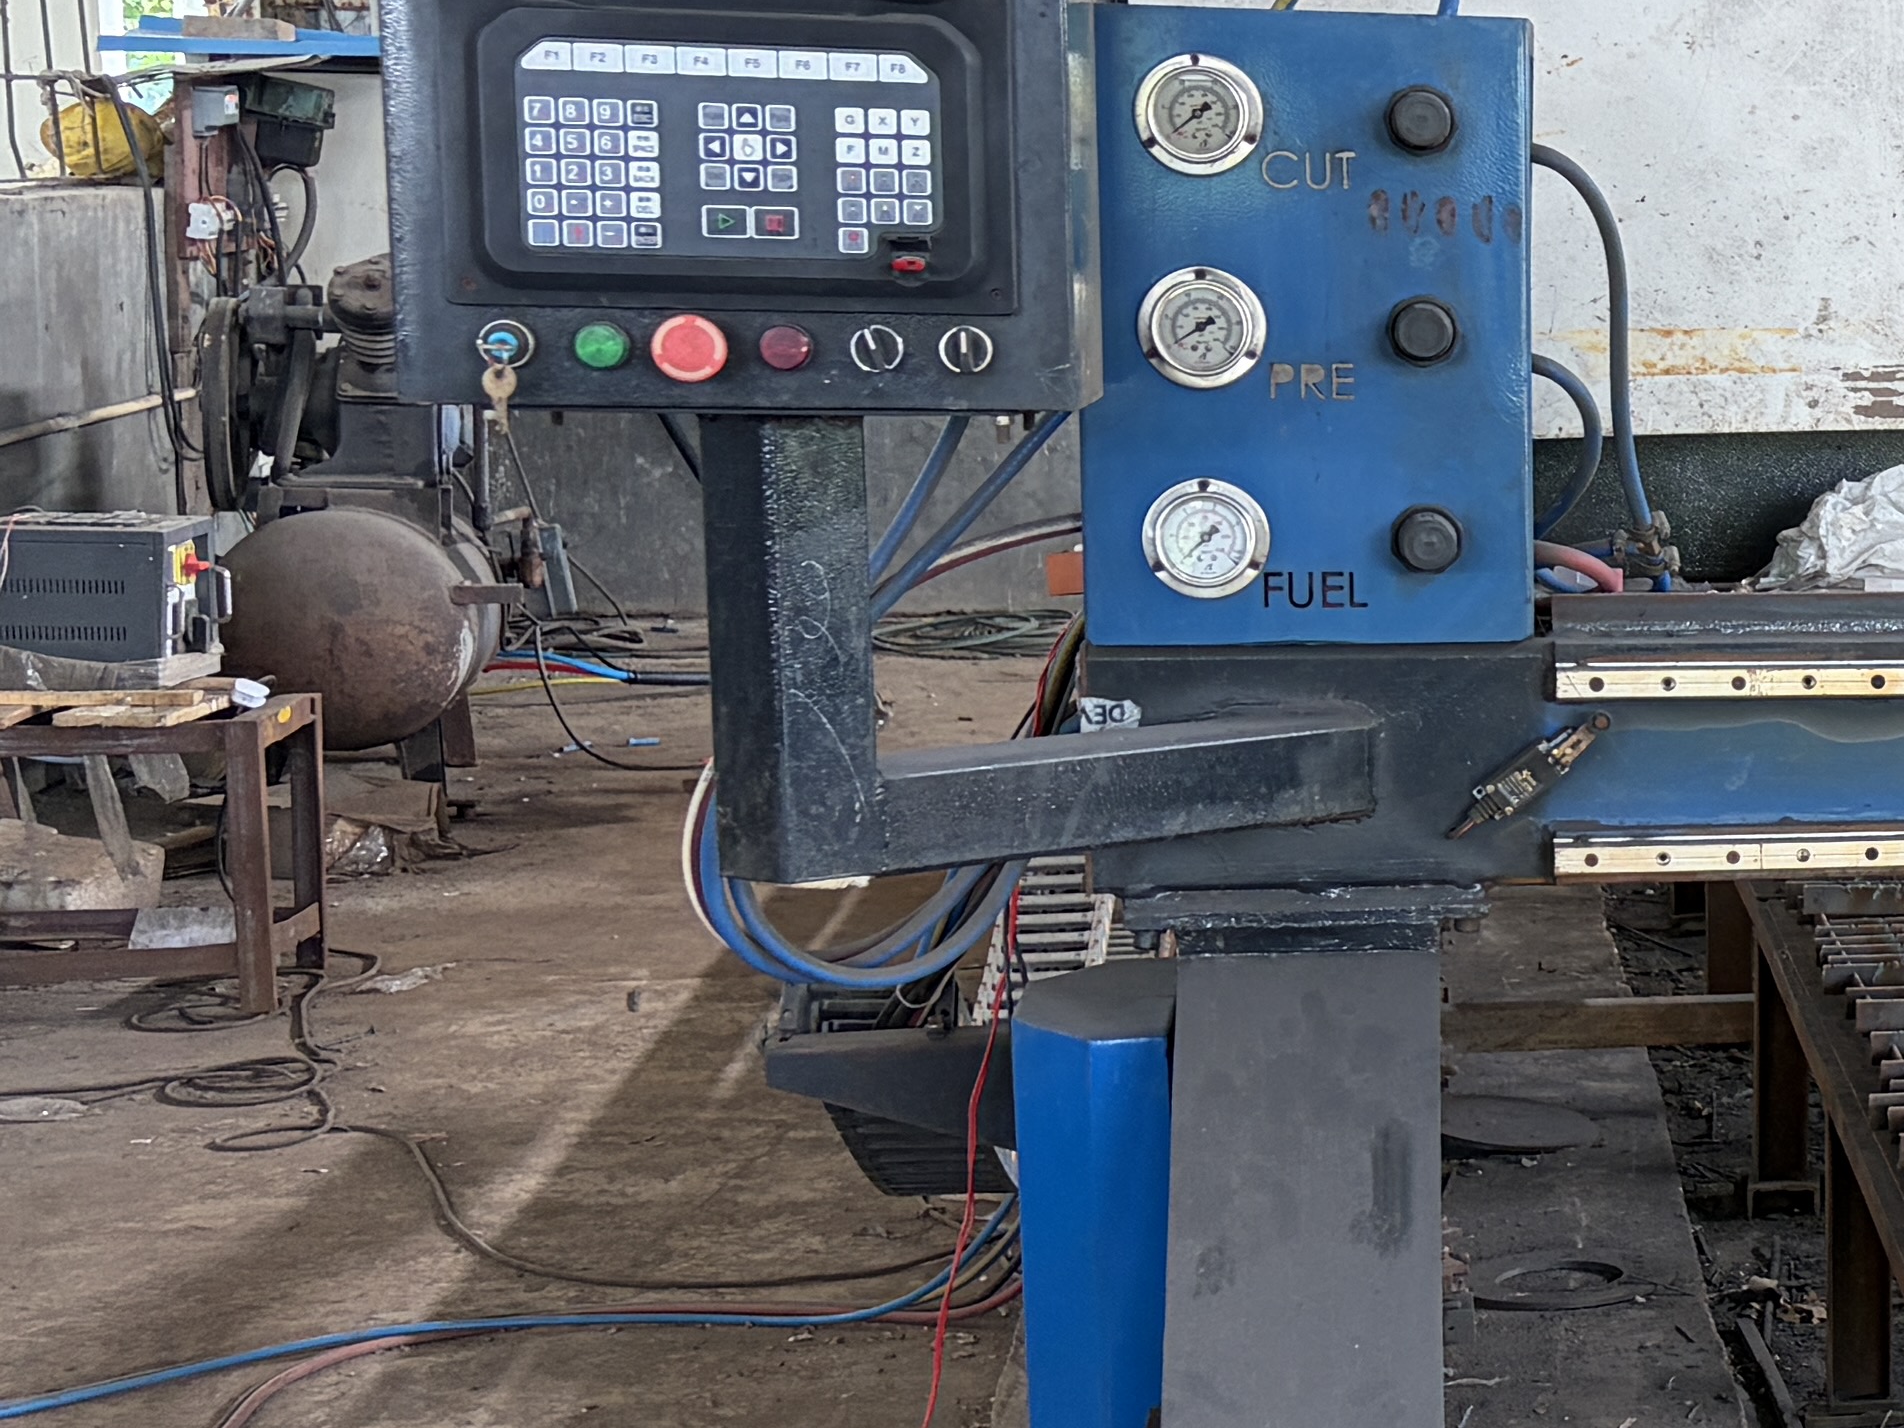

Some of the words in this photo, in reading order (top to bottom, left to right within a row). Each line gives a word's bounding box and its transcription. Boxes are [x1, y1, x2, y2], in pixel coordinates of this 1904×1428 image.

[544, 50, 560, 61] F1
[590, 52, 607, 63] F2
[641, 54, 658, 65] F3
[693, 56, 710, 66] F4
[744, 58, 761, 69] F5
[845, 62, 861, 72] F7
[890, 63, 906, 74] F8
[531, 103, 542, 117] 7
[565, 104, 577, 118] 8
[600, 105, 611, 119] 9
[877, 116, 888, 127] X
[910, 117, 920, 127] Y
[531, 134, 543, 148] 4
[567, 134, 578, 149] 5
[601, 135, 612, 150] 6
[846, 145, 856, 156] F
[878, 146, 889, 157] M
[911, 147, 921, 158] Z
[534, 164, 542, 178] 1
[568, 165, 579, 179] 2
[602, 166, 613, 180] 3
[1261, 150, 1356, 190] CUT
[1269, 363, 1355, 400] PRE
[1263, 571, 1369, 608] FUEL
